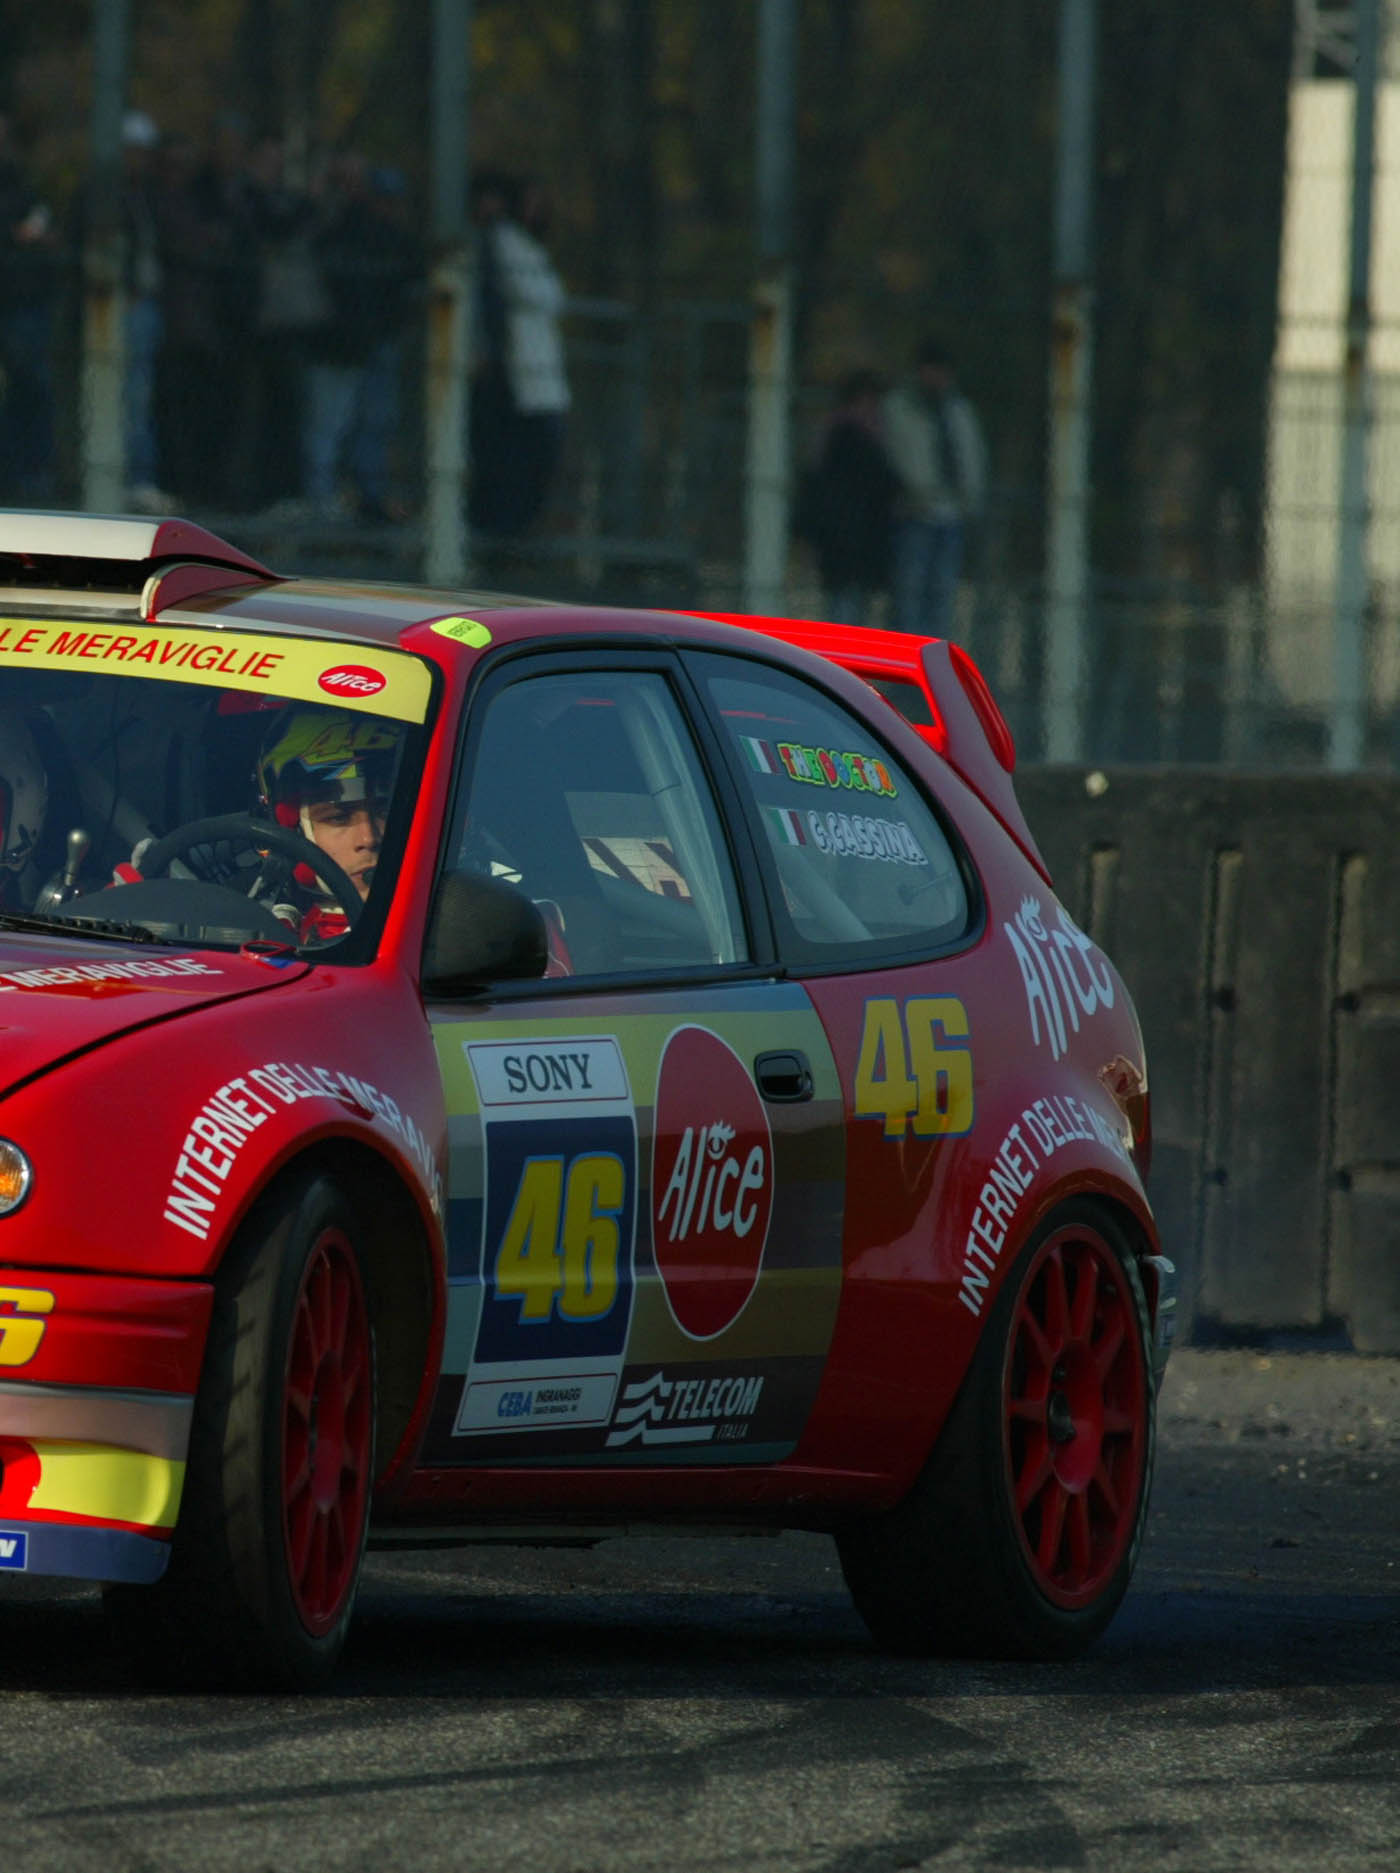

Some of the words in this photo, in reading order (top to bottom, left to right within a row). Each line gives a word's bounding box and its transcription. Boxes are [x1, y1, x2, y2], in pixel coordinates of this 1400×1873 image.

[46, 631, 284, 679] MERAVIGLIE
[320, 672, 382, 692] Alice
[10, 957, 224, 992] MERAVIGLIE
[1004, 896, 1114, 1061] Alice
[504, 1053, 593, 1094] SONY
[854, 994, 974, 1141] 46
[164, 1077, 276, 1240] INTERNET
[248, 1063, 354, 1105] DELLE
[658, 1120, 764, 1241] Alice
[494, 1150, 625, 1324] 46
[958, 1122, 1039, 1317] INTERNET
[1022, 1096, 1095, 1157] DELLE
[497, 1391, 532, 1417] CEBA
[667, 1376, 764, 1420] TELECOM
